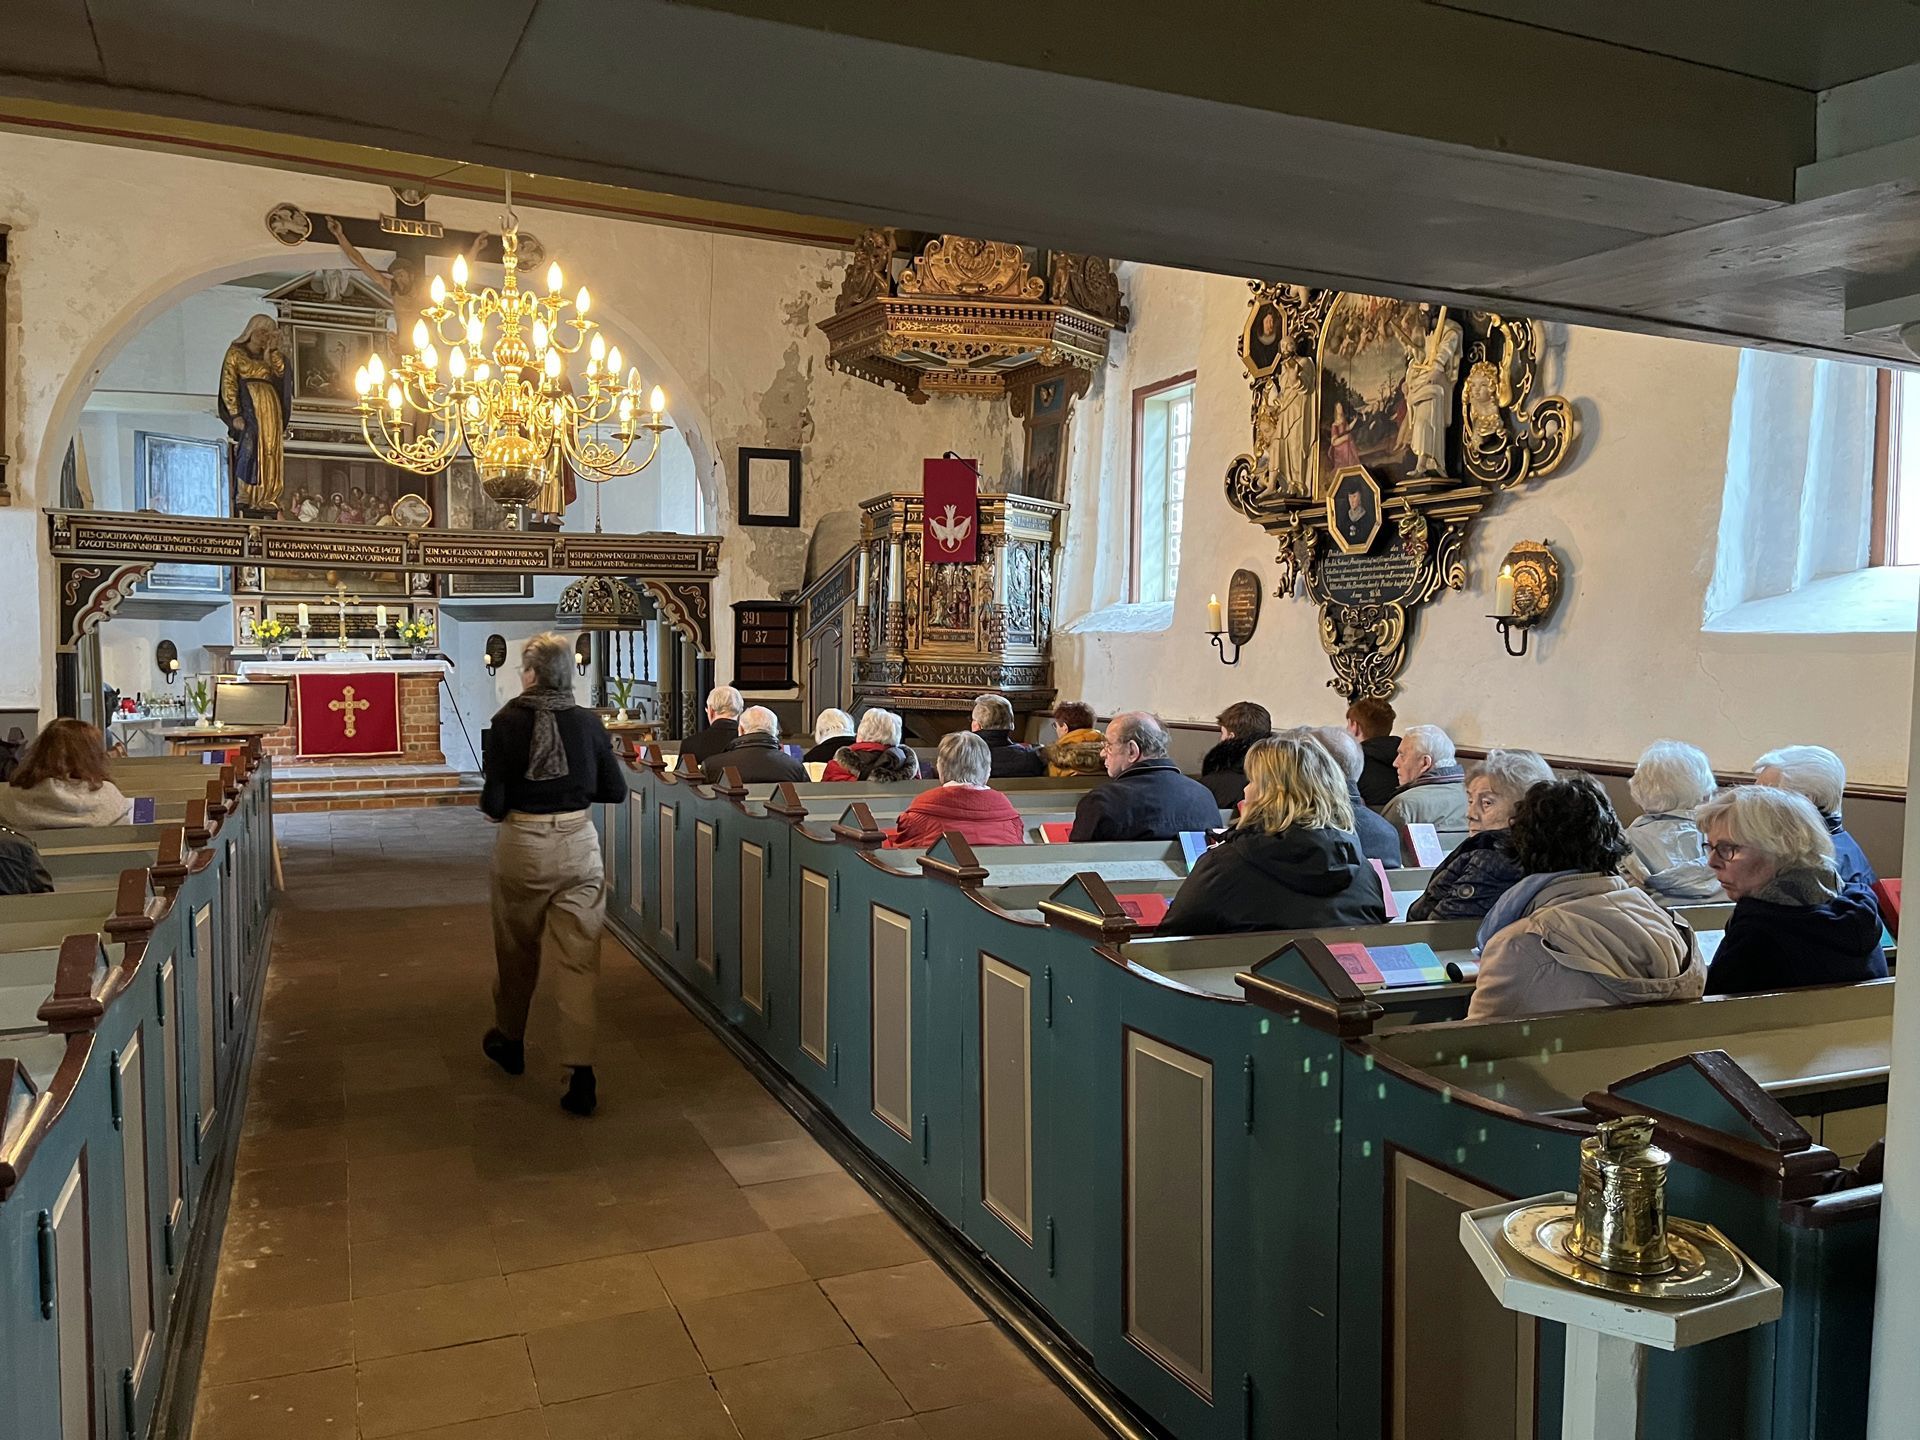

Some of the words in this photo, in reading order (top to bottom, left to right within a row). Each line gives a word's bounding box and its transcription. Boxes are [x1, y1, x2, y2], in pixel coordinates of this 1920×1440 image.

[391, 218, 432, 236] INRI
[742, 611, 760, 625] 391
[755, 630, 768, 644] 37
